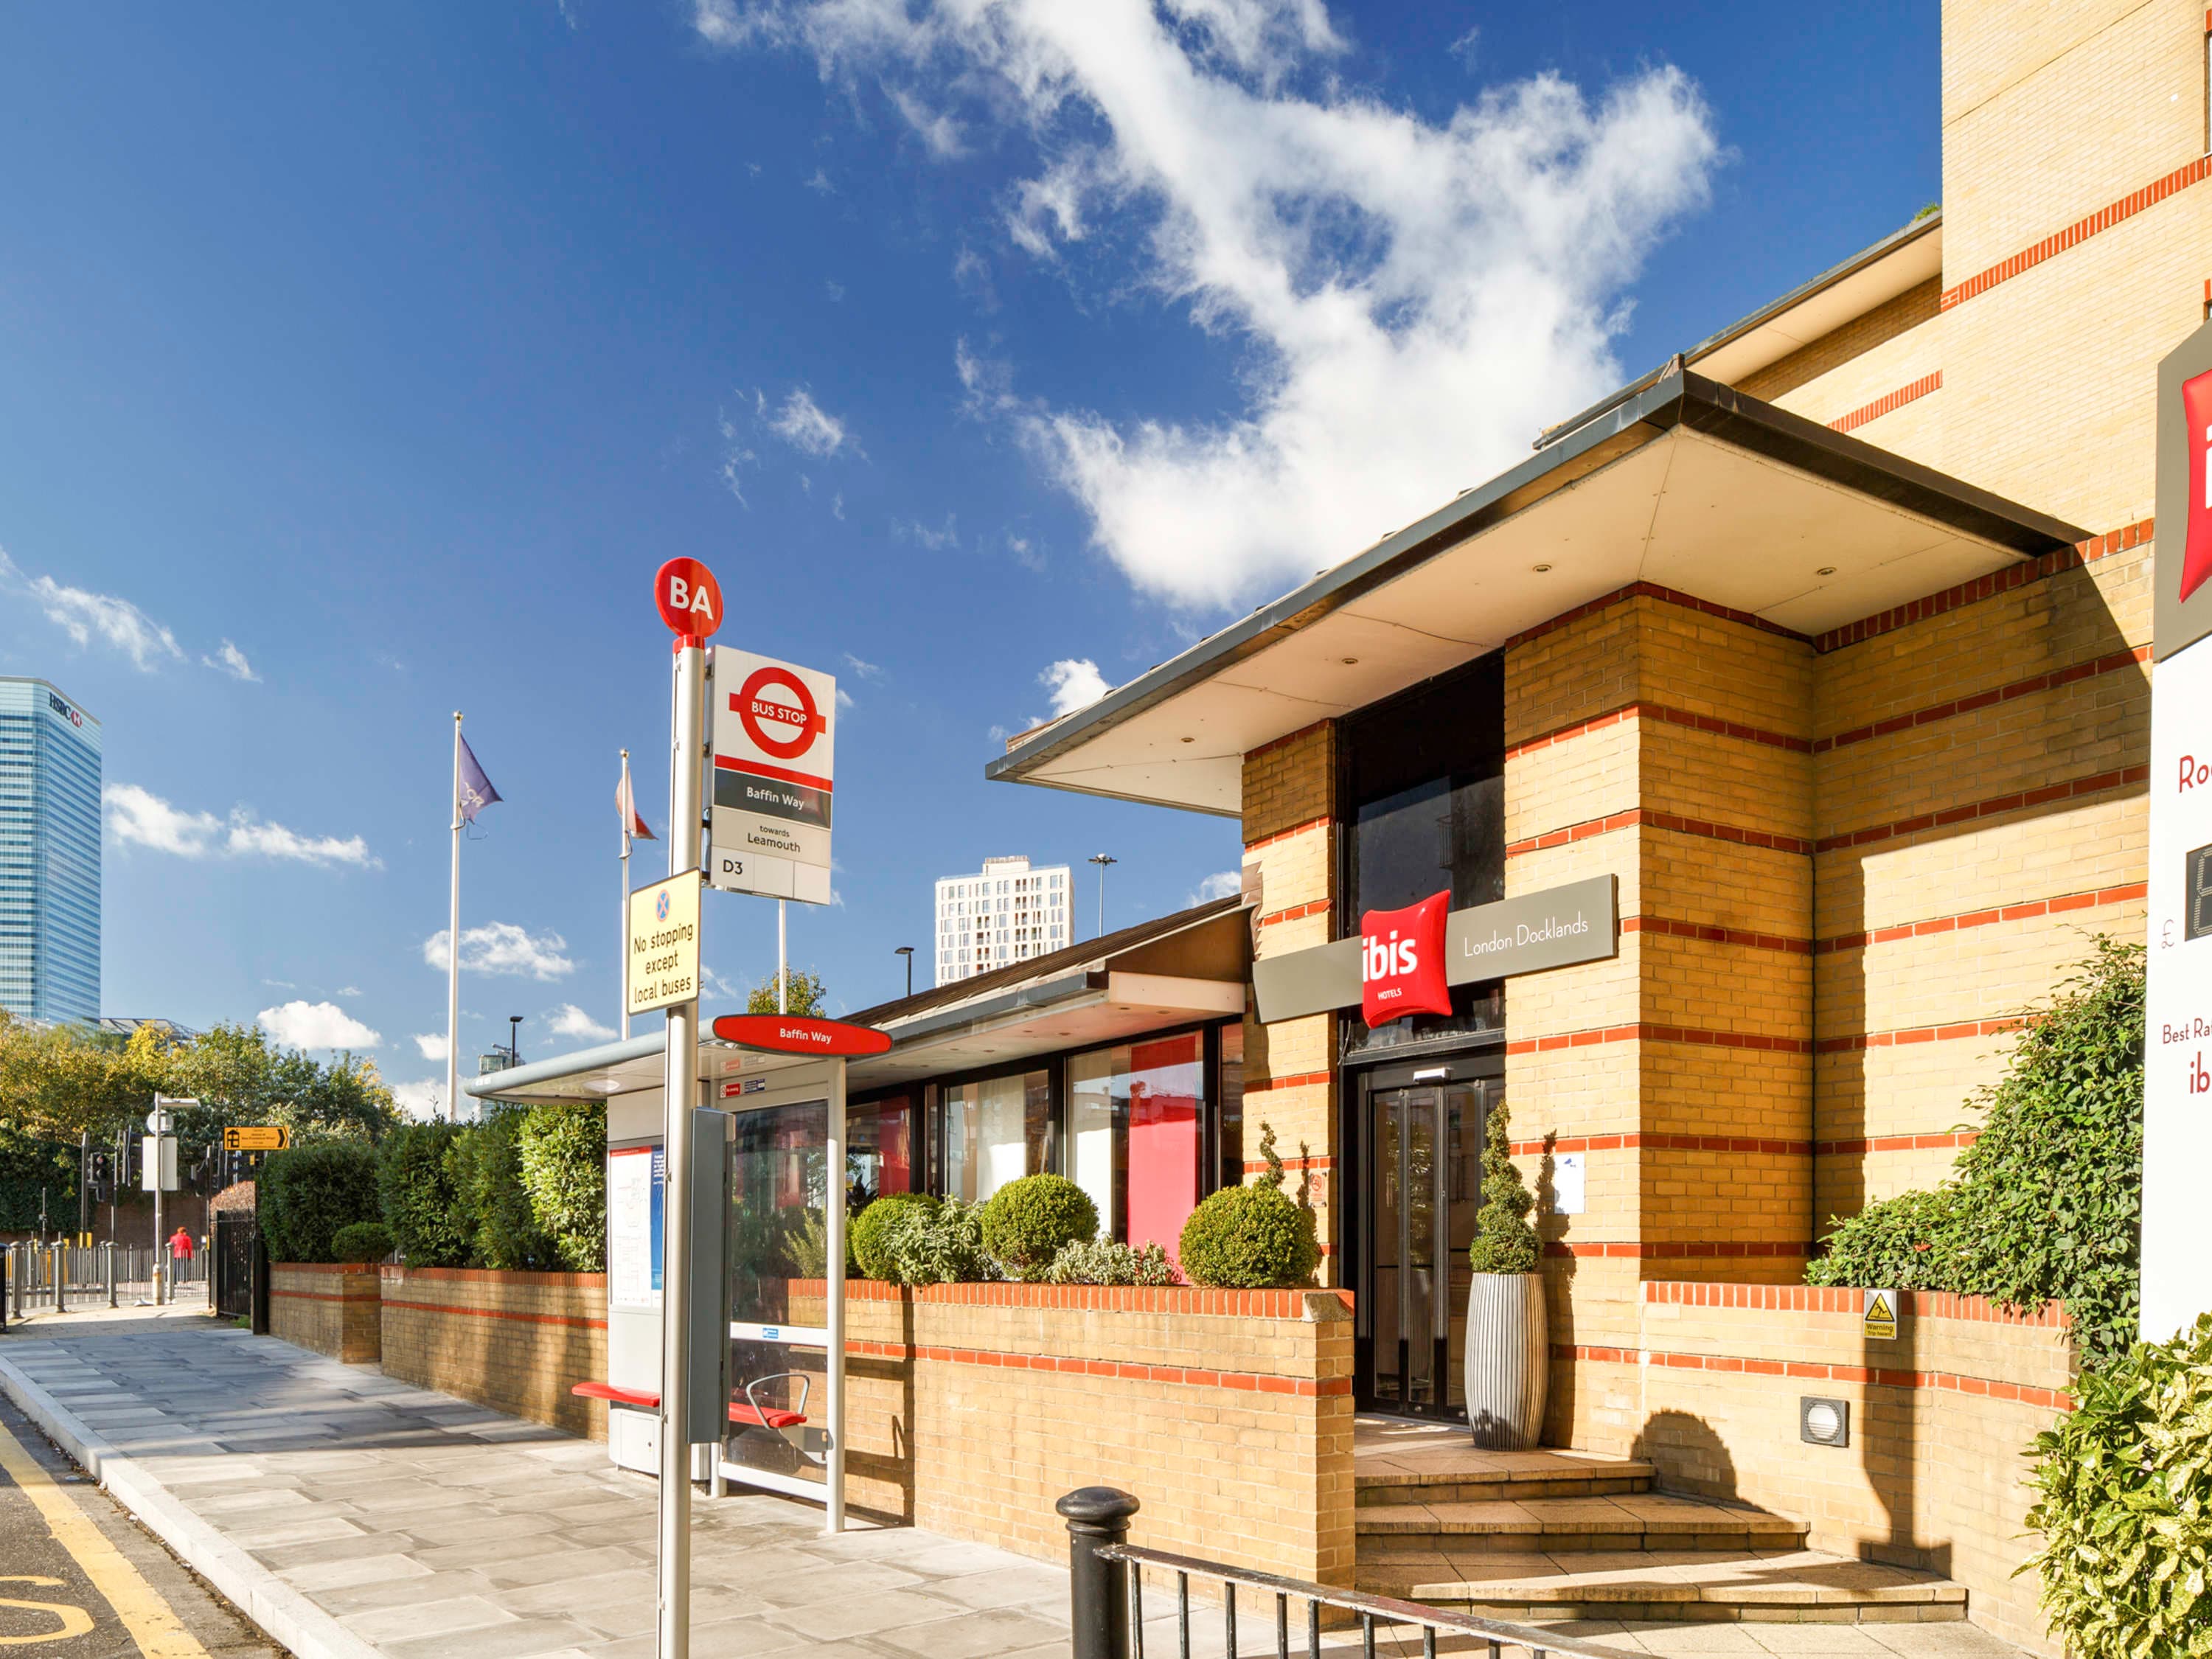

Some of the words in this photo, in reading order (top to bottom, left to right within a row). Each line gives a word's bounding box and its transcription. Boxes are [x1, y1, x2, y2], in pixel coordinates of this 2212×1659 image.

[669, 575, 714, 621] BA
[49, 692, 72, 720] HSBC
[751, 701, 775, 717] BUS
[777, 708, 807, 724] STOP
[2179, 754, 2212, 793] Ro
[746, 786, 779, 803] Baffin
[782, 794, 804, 810] Way
[747, 832, 801, 853] Leamouth
[759, 825, 790, 838] towards
[723, 859, 743, 875] D3
[633, 936, 647, 955] No
[650, 922, 693, 949] stopping
[1464, 929, 1512, 957] London
[1516, 910, 1589, 947] Docklands
[645, 950, 678, 975] except
[1362, 930, 1419, 984] ibis
[634, 981, 658, 1004] local
[661, 976, 692, 998] buses
[1377, 987, 1403, 1001] HOTELS
[779, 1027, 809, 1040] Baffin
[811, 1031, 832, 1045] Way
[2162, 1023, 2190, 1044] Best
[2194, 1018, 2212, 1039] Ra
[1866, 1324, 1893, 1333] Warning
